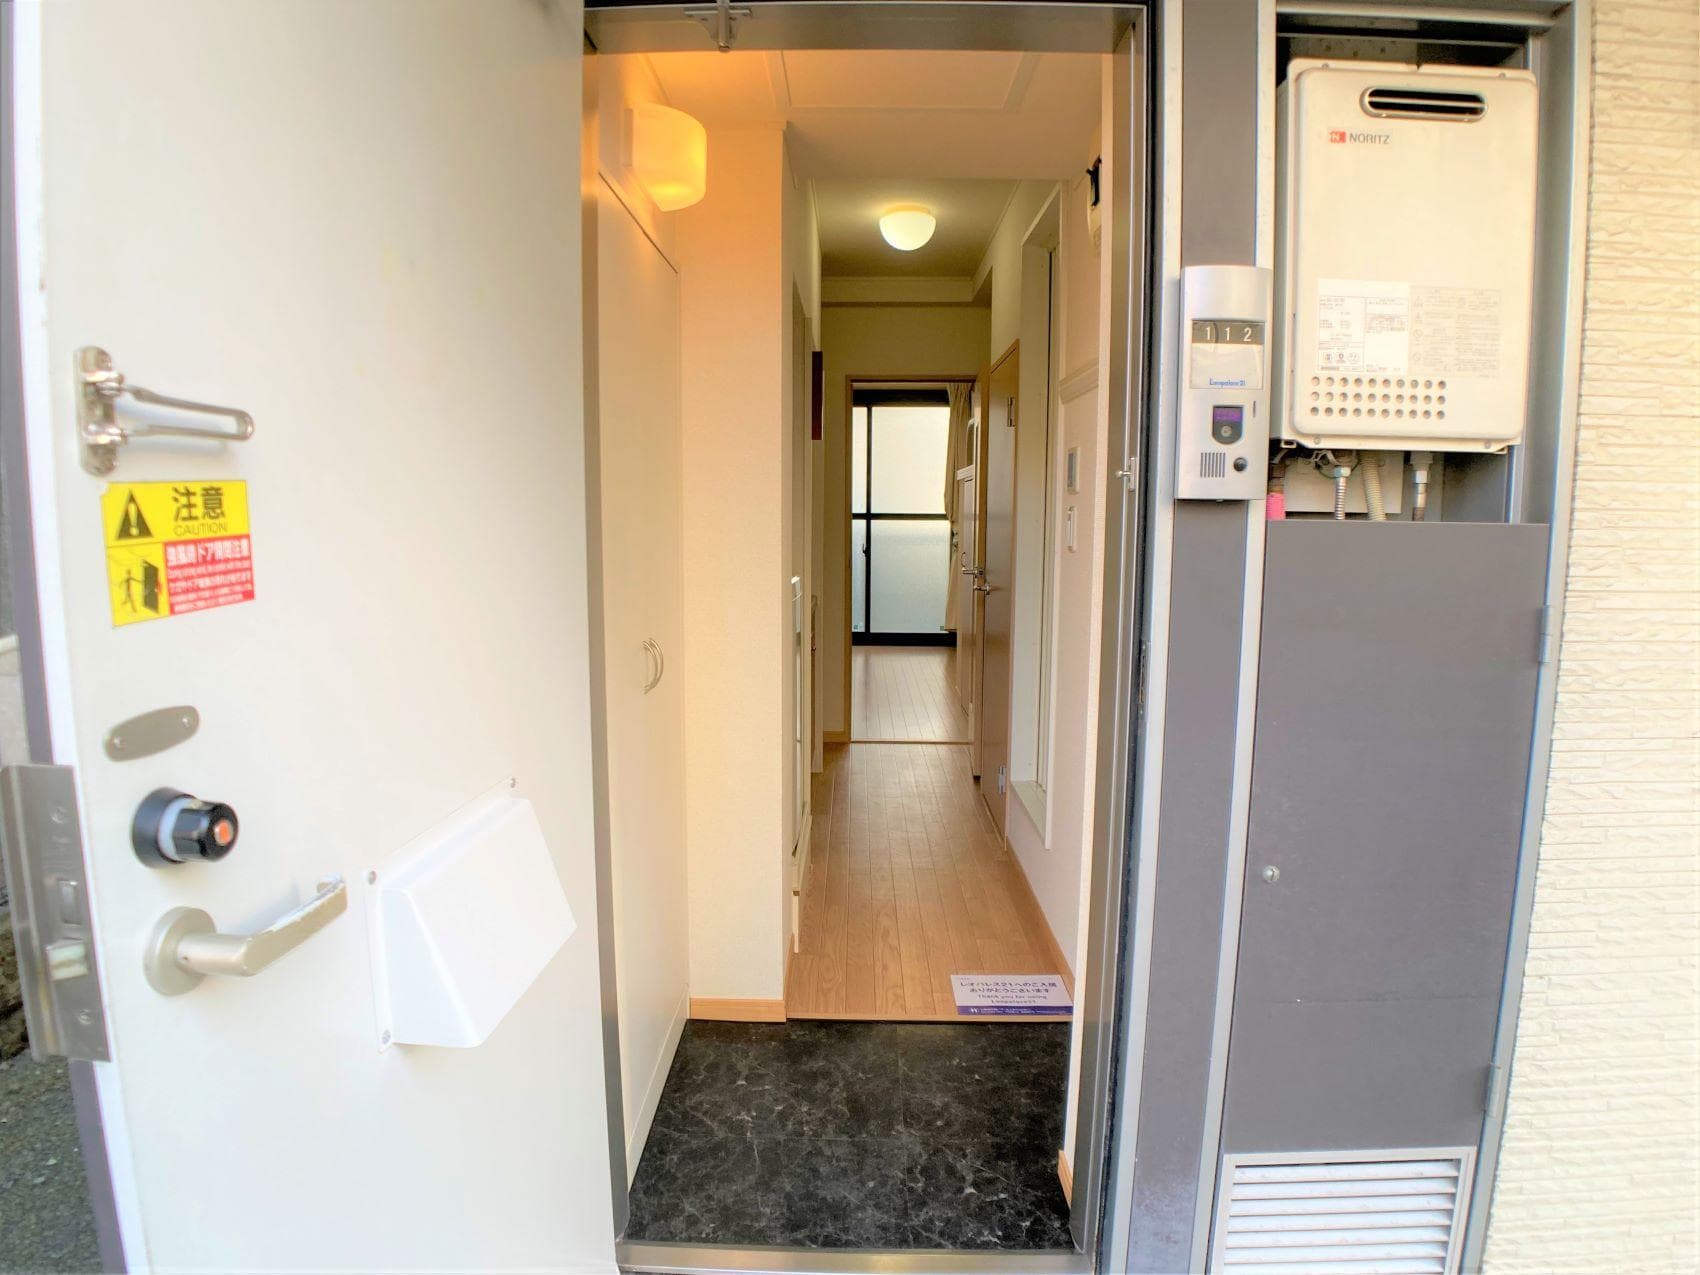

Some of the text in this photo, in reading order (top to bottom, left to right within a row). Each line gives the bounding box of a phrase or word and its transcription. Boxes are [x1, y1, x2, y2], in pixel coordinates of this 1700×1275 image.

[1349, 132, 1391, 145] NORITZ
[171, 485, 226, 522] 注意
[173, 522, 229, 537] CAUTION
